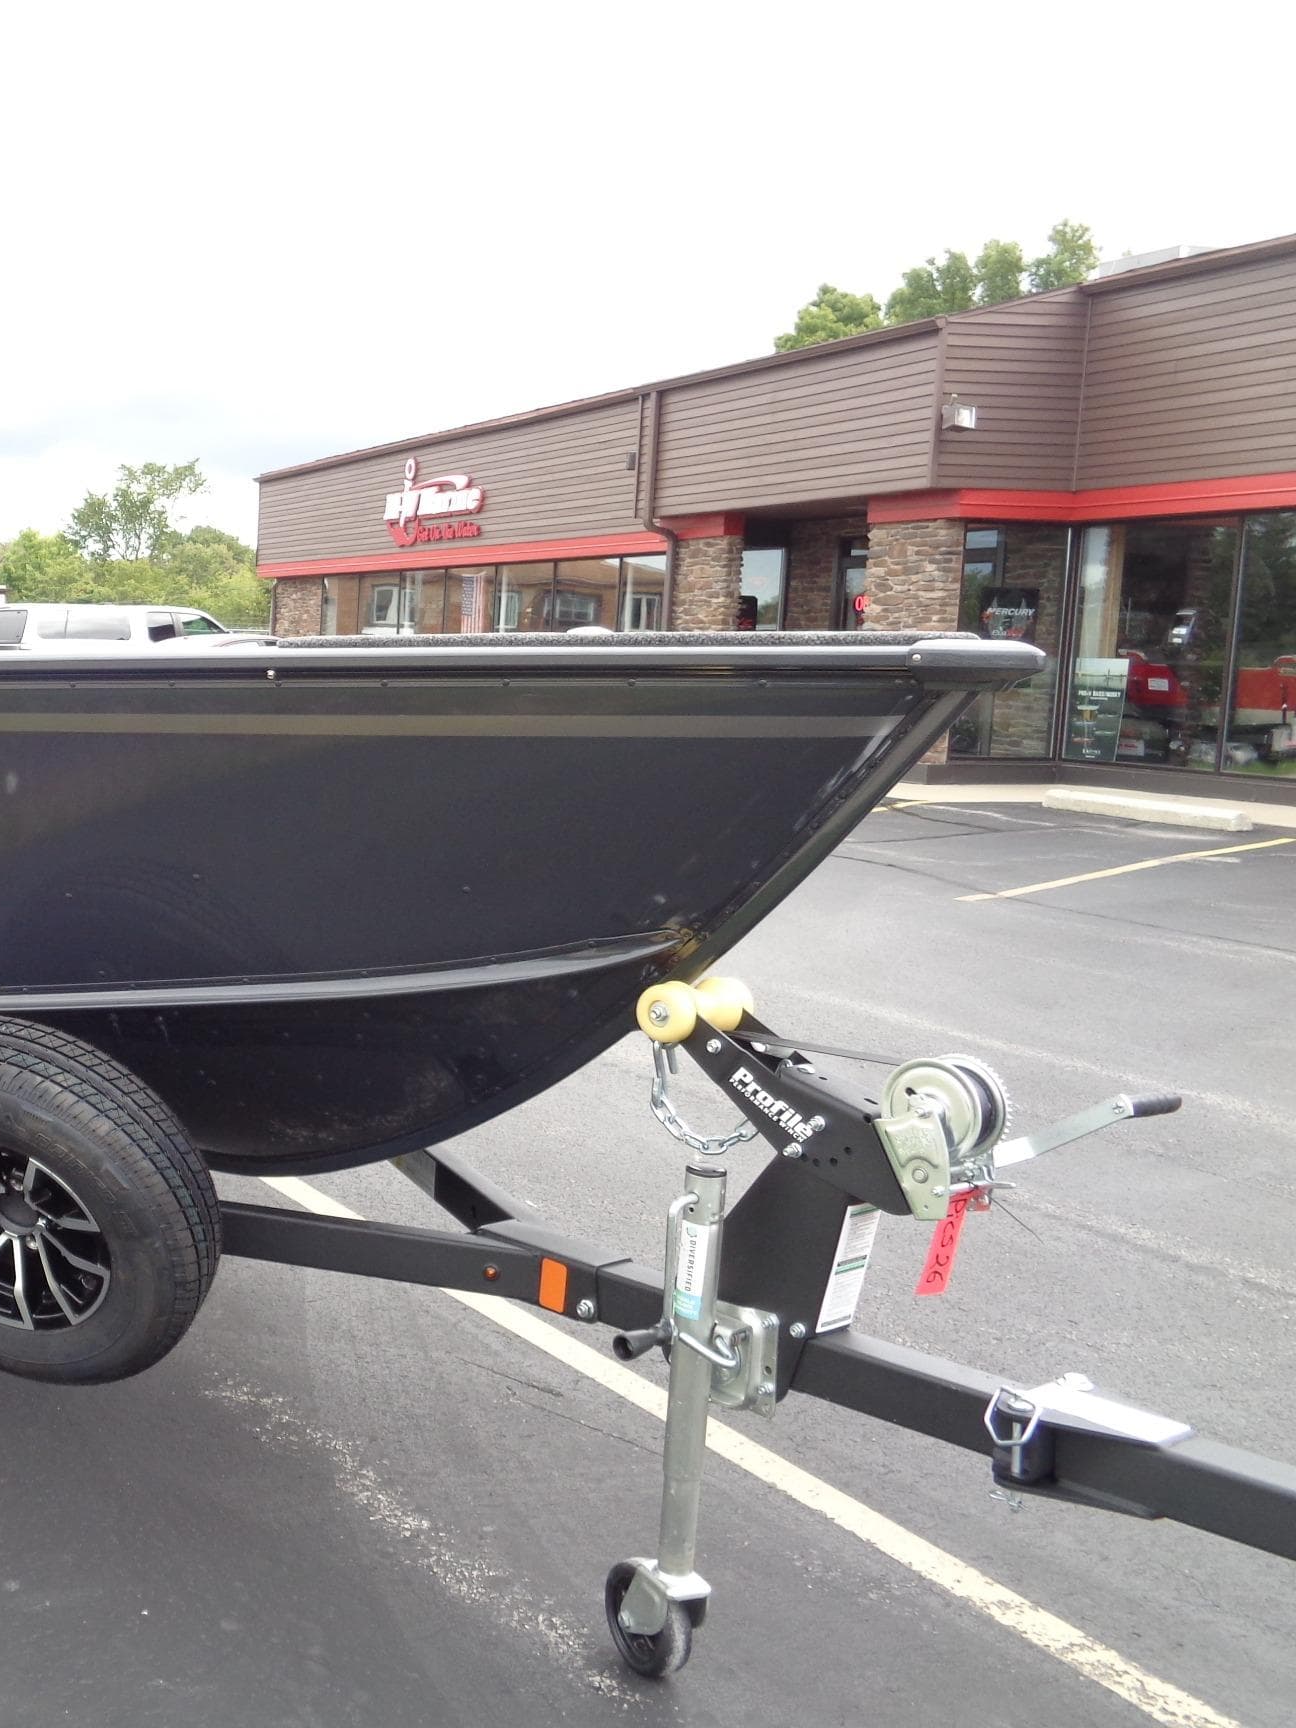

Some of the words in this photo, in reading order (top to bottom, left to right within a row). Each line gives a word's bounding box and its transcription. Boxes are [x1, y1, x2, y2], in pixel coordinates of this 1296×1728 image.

[986, 607, 1035, 616] MERCURY
[729, 1078, 779, 1121] PERFORMANCE
[779, 1120, 805, 1143] WINCH
[730, 1066, 813, 1140] Profile
[684, 1239, 697, 1292] DIVERSIFIED
